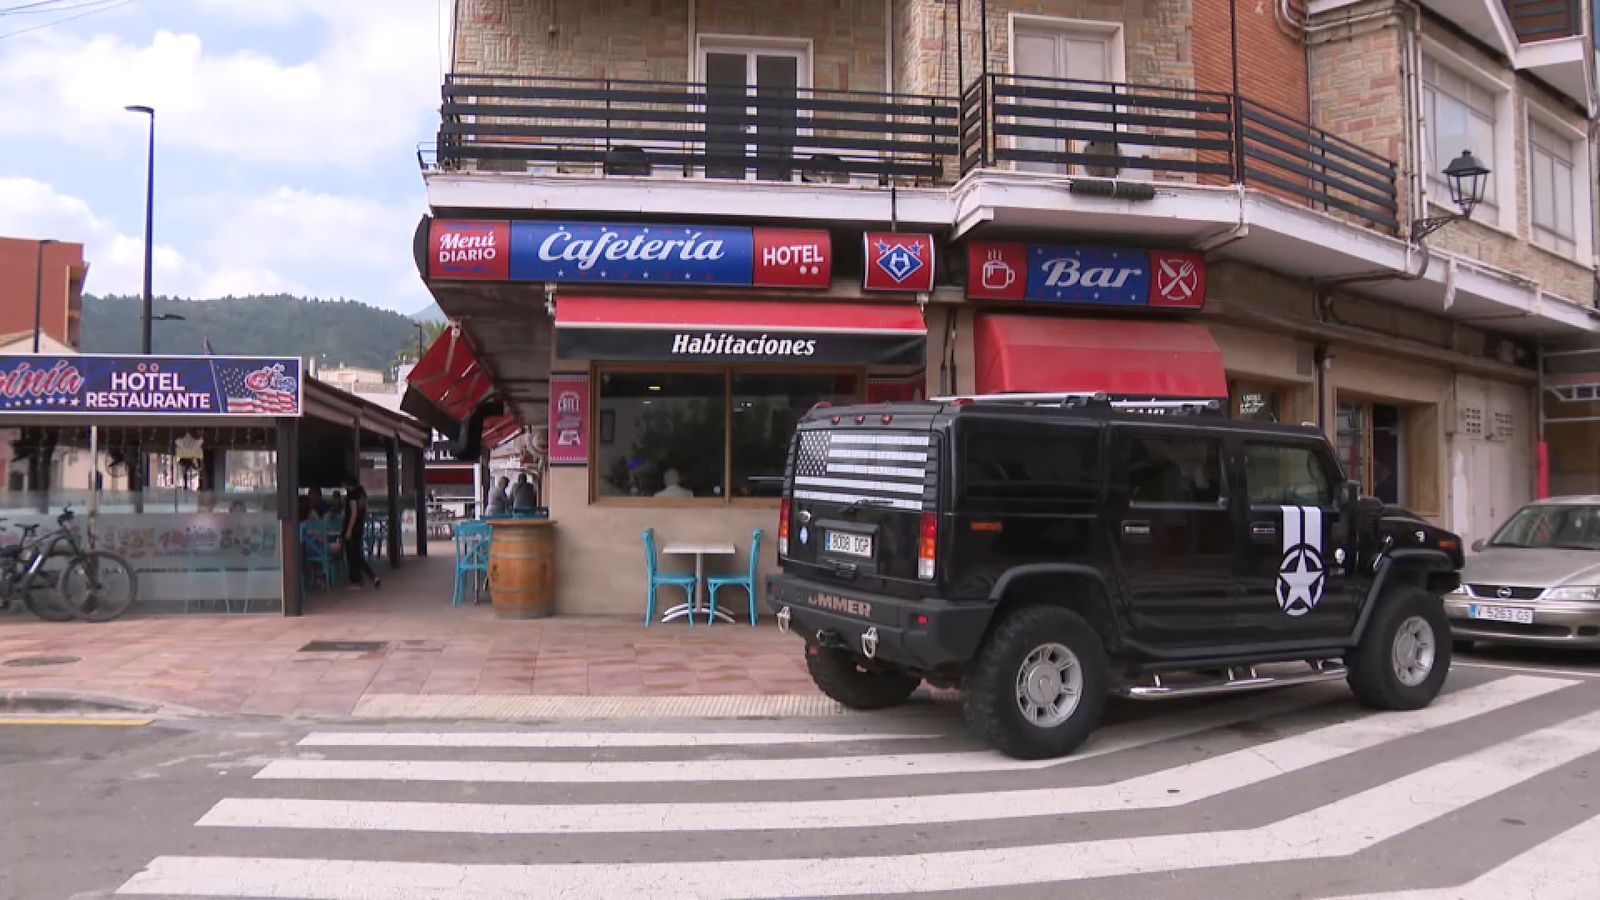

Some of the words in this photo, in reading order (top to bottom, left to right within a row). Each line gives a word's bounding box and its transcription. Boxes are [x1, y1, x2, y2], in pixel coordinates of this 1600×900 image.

[440, 231, 496, 249] Menú
[440, 247, 496, 263] DIARIO
[538, 231, 725, 270] Cafetería
[762, 244, 824, 267] HOTEL
[1041, 258, 1142, 288] Bar
[672, 333, 816, 355] Habitaciones
[111, 372, 186, 391] HOTEL
[86, 391, 211, 409] RESTAURANTE
